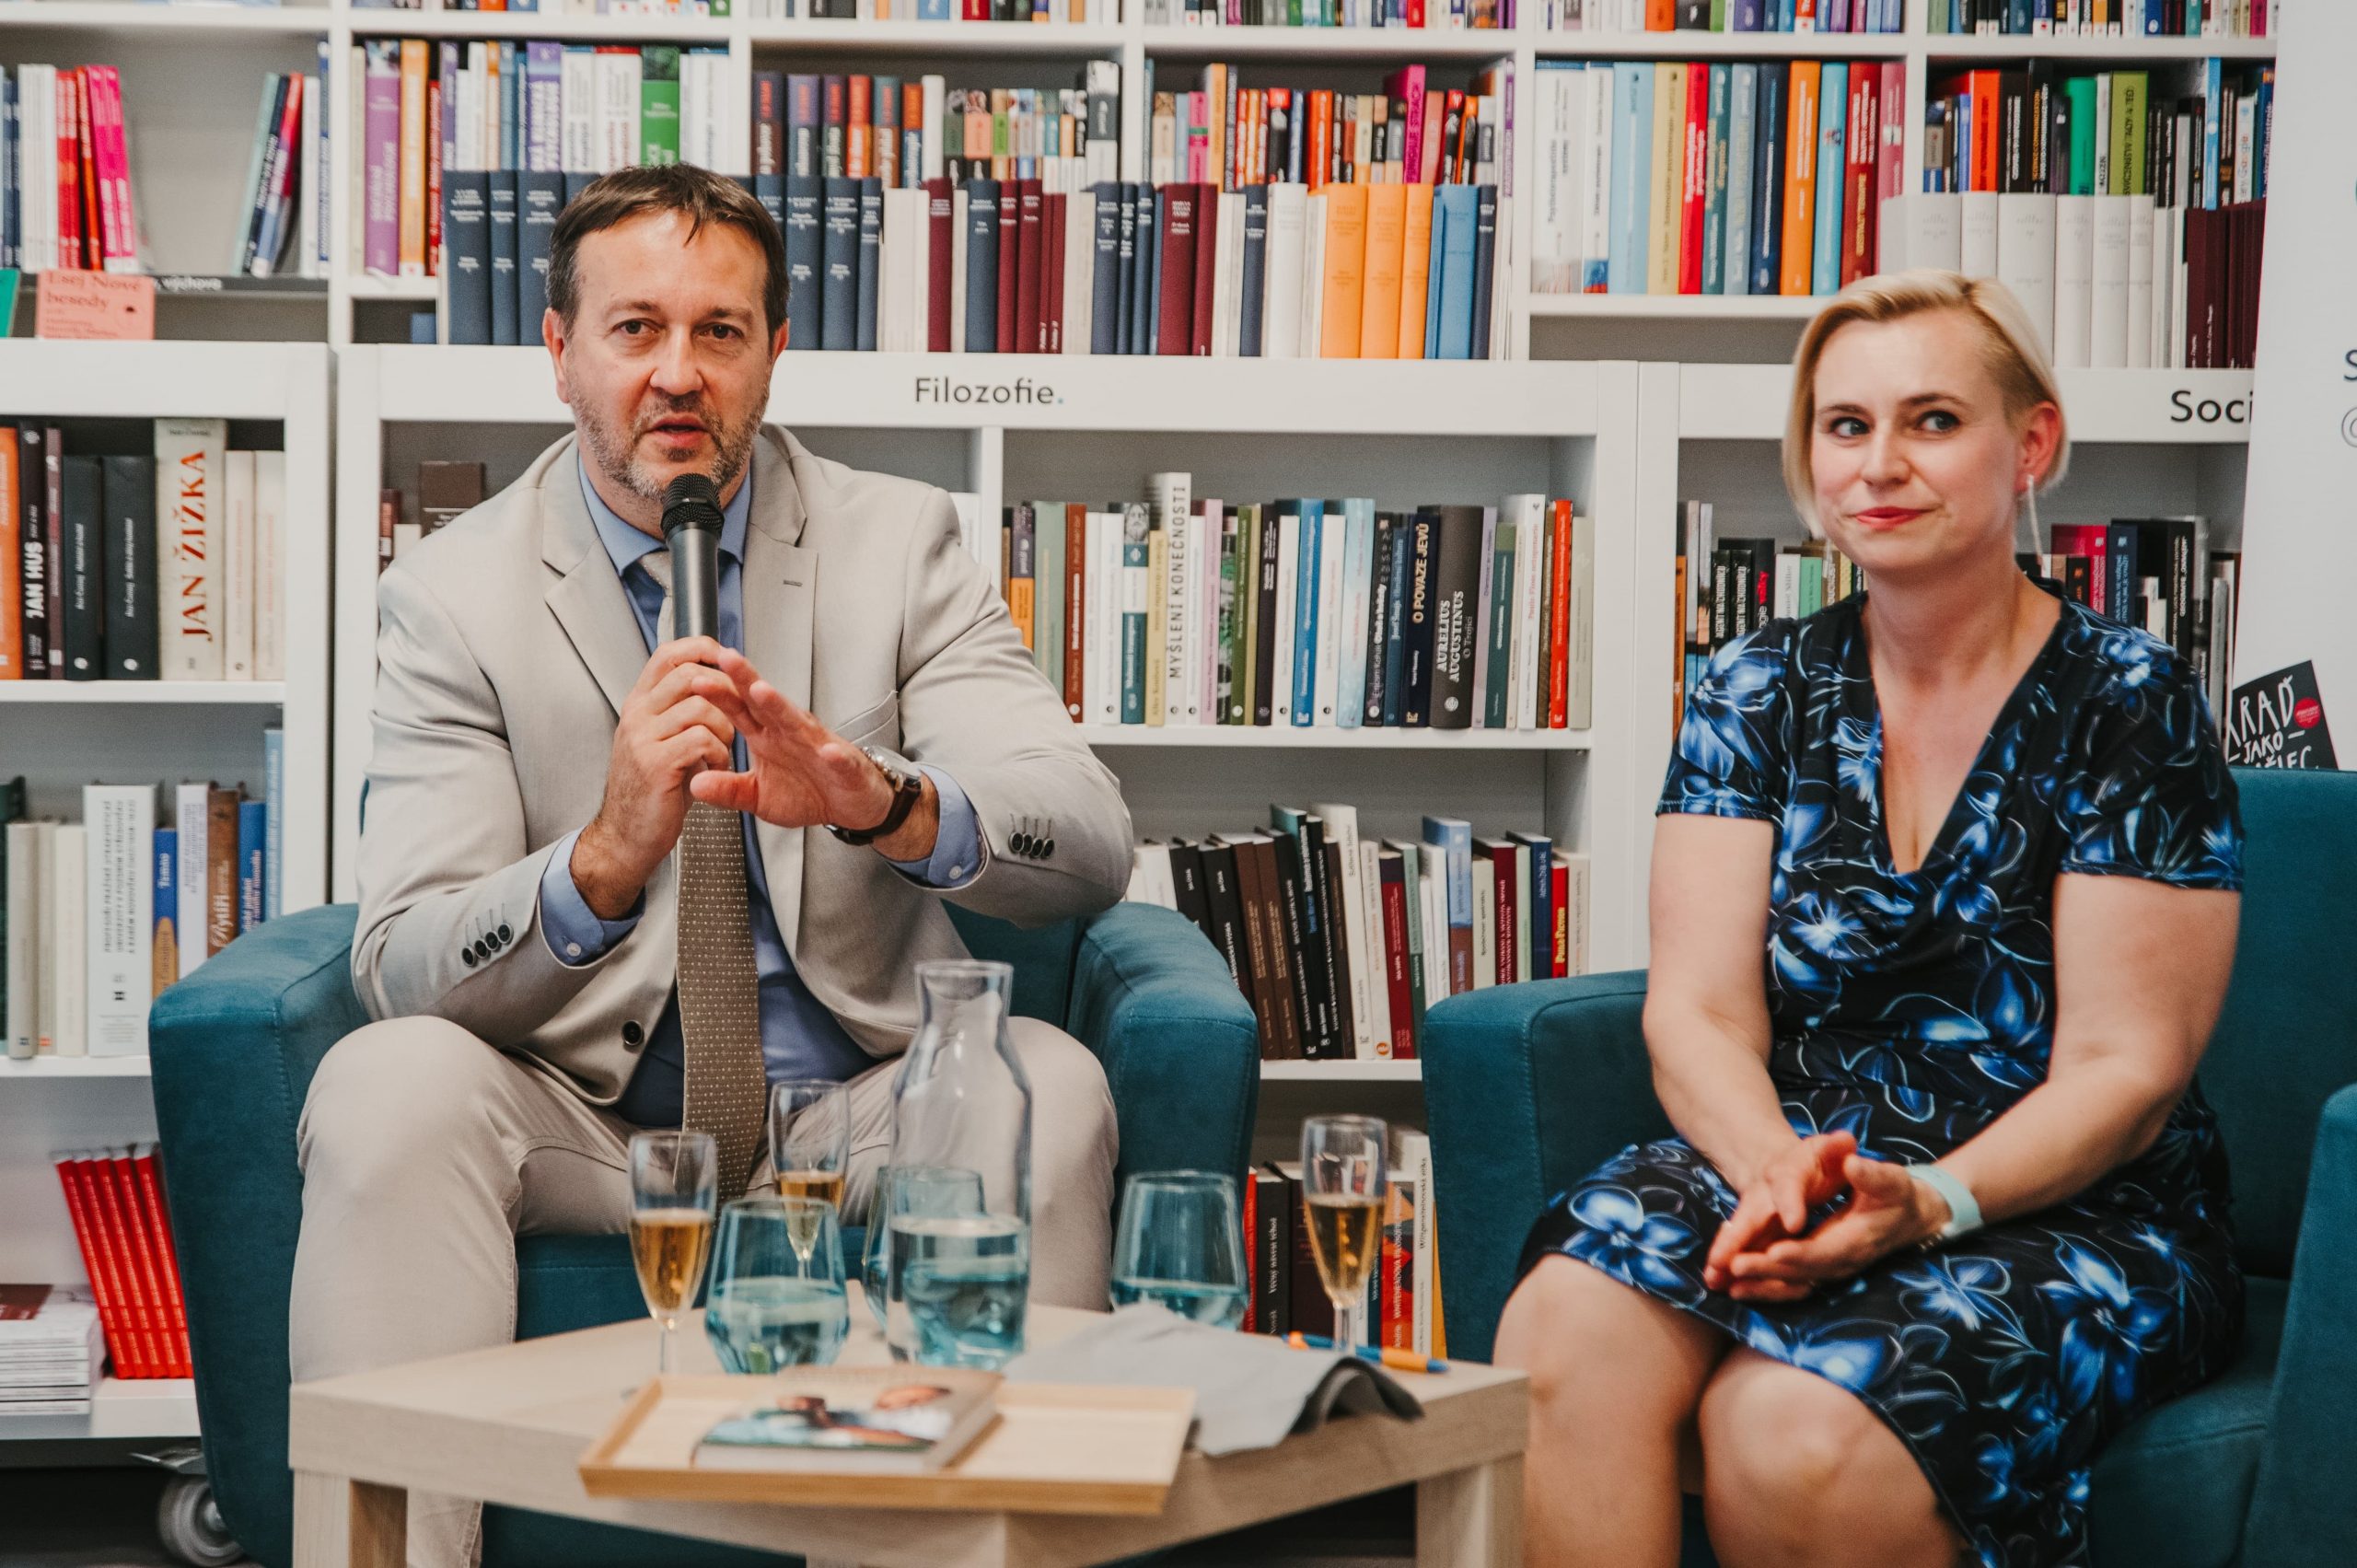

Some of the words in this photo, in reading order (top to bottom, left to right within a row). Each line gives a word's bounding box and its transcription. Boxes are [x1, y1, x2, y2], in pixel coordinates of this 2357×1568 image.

[915, 376, 1064, 405] Filozofie.
[173, 449, 206, 562] ŽIŽKA
[23, 541, 44, 579] HUS
[1167, 485, 1186, 596] KONEČNOSTI
[1415, 523, 1430, 558] JEVŮ
[24, 583, 45, 618] JAN
[180, 575, 214, 643] JAN
[1413, 558, 1428, 610] POVAZE
[1166, 603, 1184, 679] MYŠLENÍ
[1412, 610, 1425, 624] O
[1436, 599, 1452, 672] AURELIUS
[1450, 590, 1465, 683] AUGUSTINUS
[2244, 729, 2283, 764] JAKO
